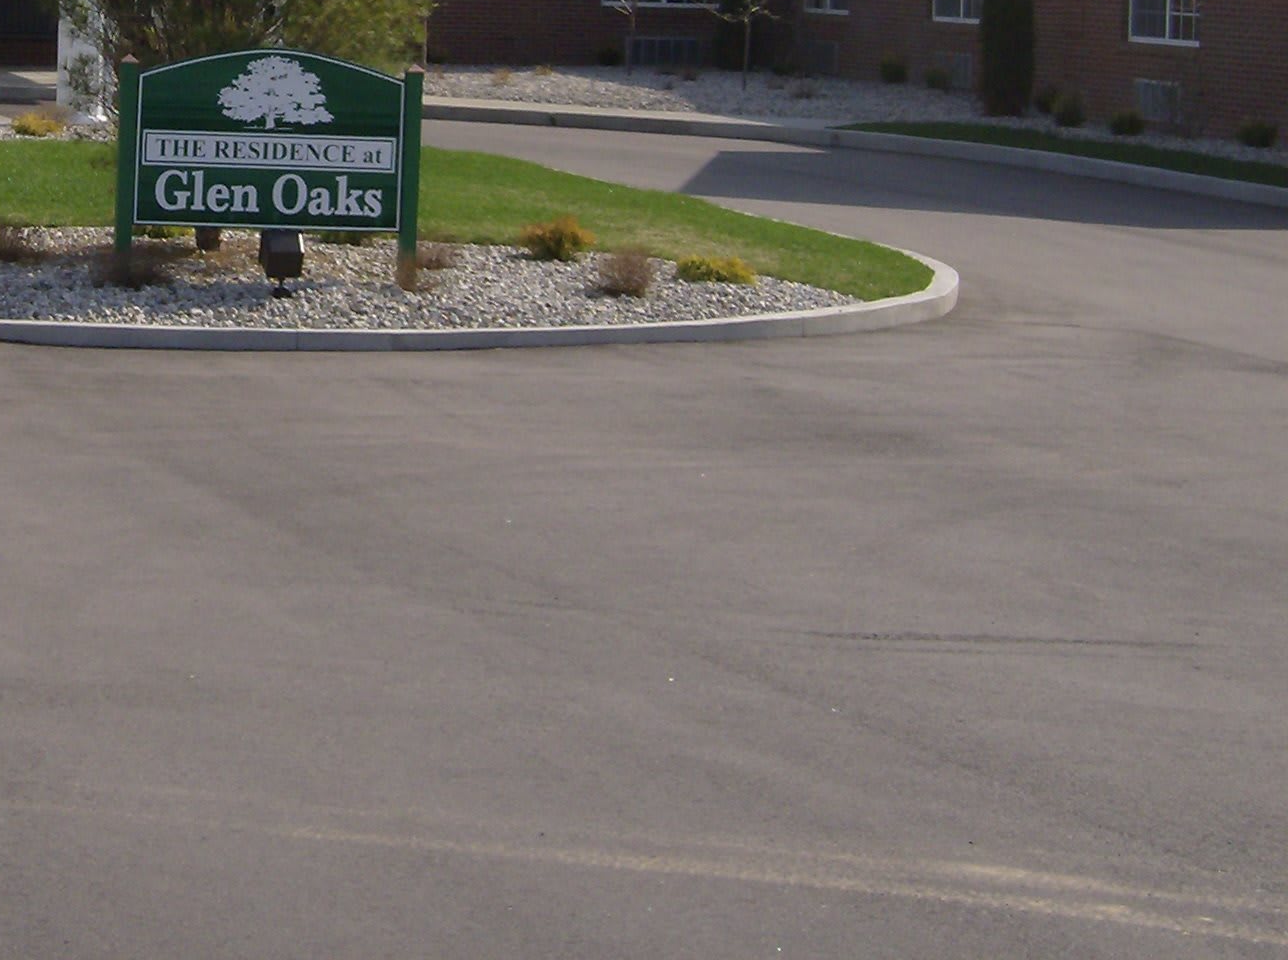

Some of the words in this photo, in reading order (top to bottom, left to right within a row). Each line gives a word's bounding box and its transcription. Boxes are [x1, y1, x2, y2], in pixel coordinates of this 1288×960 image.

[155, 138, 206, 158] THE
[214, 140, 356, 164] RESIDENCE
[363, 149, 383, 164] at
[154, 169, 260, 213] Glen
[271, 173, 383, 218] Oaks
